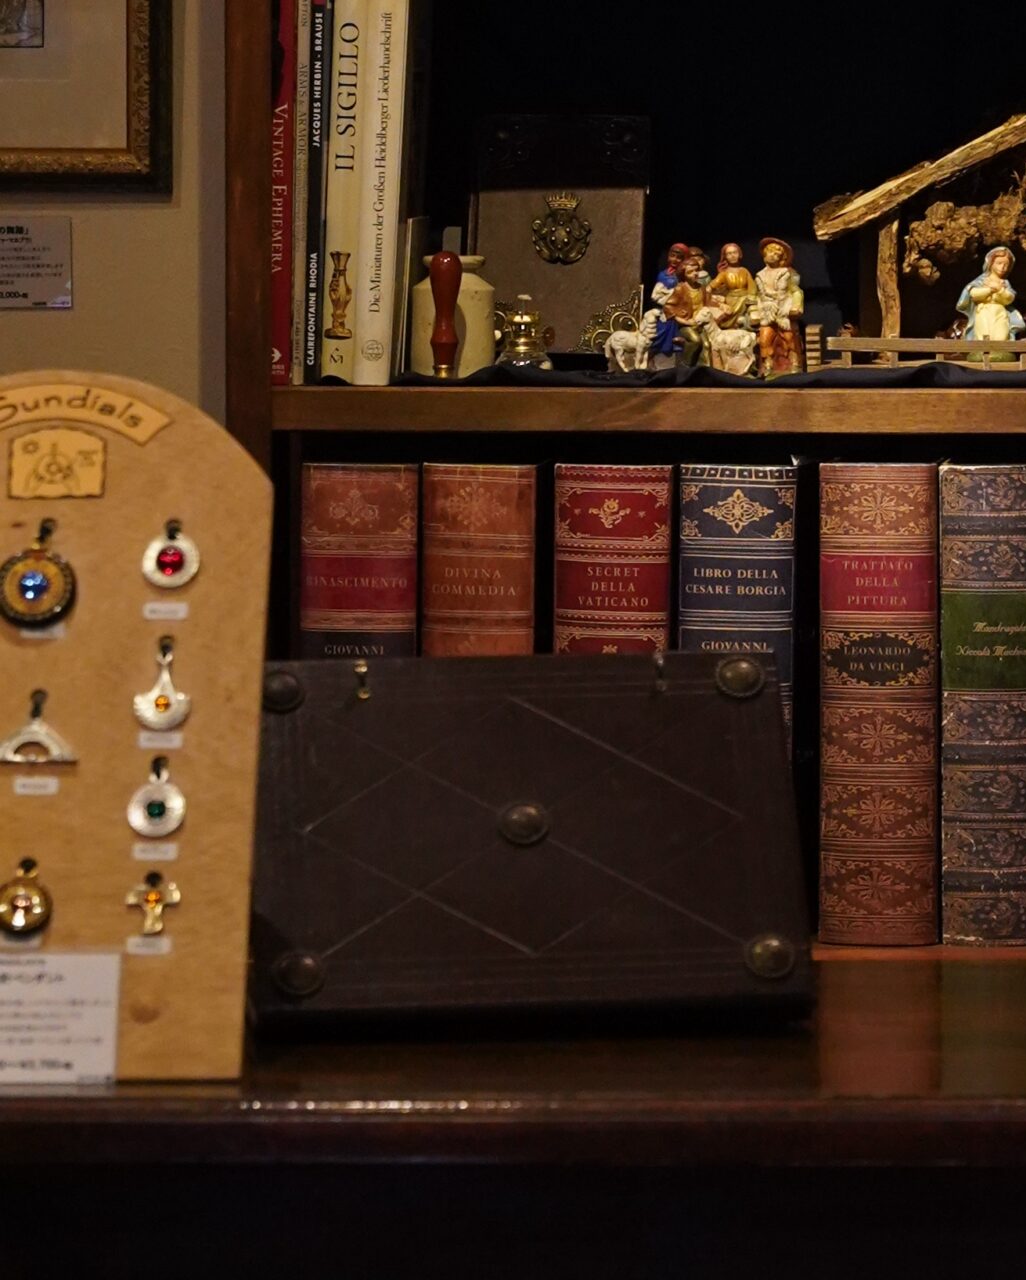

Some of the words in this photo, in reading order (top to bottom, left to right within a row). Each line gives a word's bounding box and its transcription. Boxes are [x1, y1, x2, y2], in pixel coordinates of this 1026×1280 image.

[314, 12, 324, 52] BRAUSE
[377, 12, 393, 101] Liederhandschrift
[313, 61, 323, 99] HERBIN
[335, 22, 360, 137] SIGILLO
[312, 103, 322, 148] JACQUES
[272, 103, 289, 177] VINTAGE
[375, 103, 391, 169] Heidelberger
[335, 145, 355, 171] IL
[372, 172, 386, 212] Großen
[272, 185, 288, 273] EPHEMERA
[372, 213, 385, 231] der
[308, 252, 319, 289] RHODIA
[369, 232, 384, 297] Miniaturen
[368, 297, 381, 314] Die
[305, 291, 318, 366] CLAIREFONTAINE
[0, 389, 143, 428] Sundials
[444, 567, 502, 579] DIVINA
[586, 566, 640, 578] SECRET
[693, 567, 732, 578] LIBRO
[737, 568, 779, 579] DELLA
[841, 560, 914, 571] TRATTATO
[305, 575, 408, 589] RINASCIMENTO
[591, 581, 636, 592] DELLA
[685, 584, 732, 595] CESARE
[736, 585, 787, 596] BORGIA
[855, 576, 900, 587] DELLA
[432, 584, 517, 597] COMMEDIA
[577, 596, 649, 607] VATICANO
[847, 595, 908, 606] PITTURA
[324, 644, 385, 656] GIOVANNI
[701, 640, 769, 652] GIOVANNI
[843, 646, 911, 656] LEONARDO
[849, 661, 865, 672] DA
[868, 662, 905, 672] VINCI
